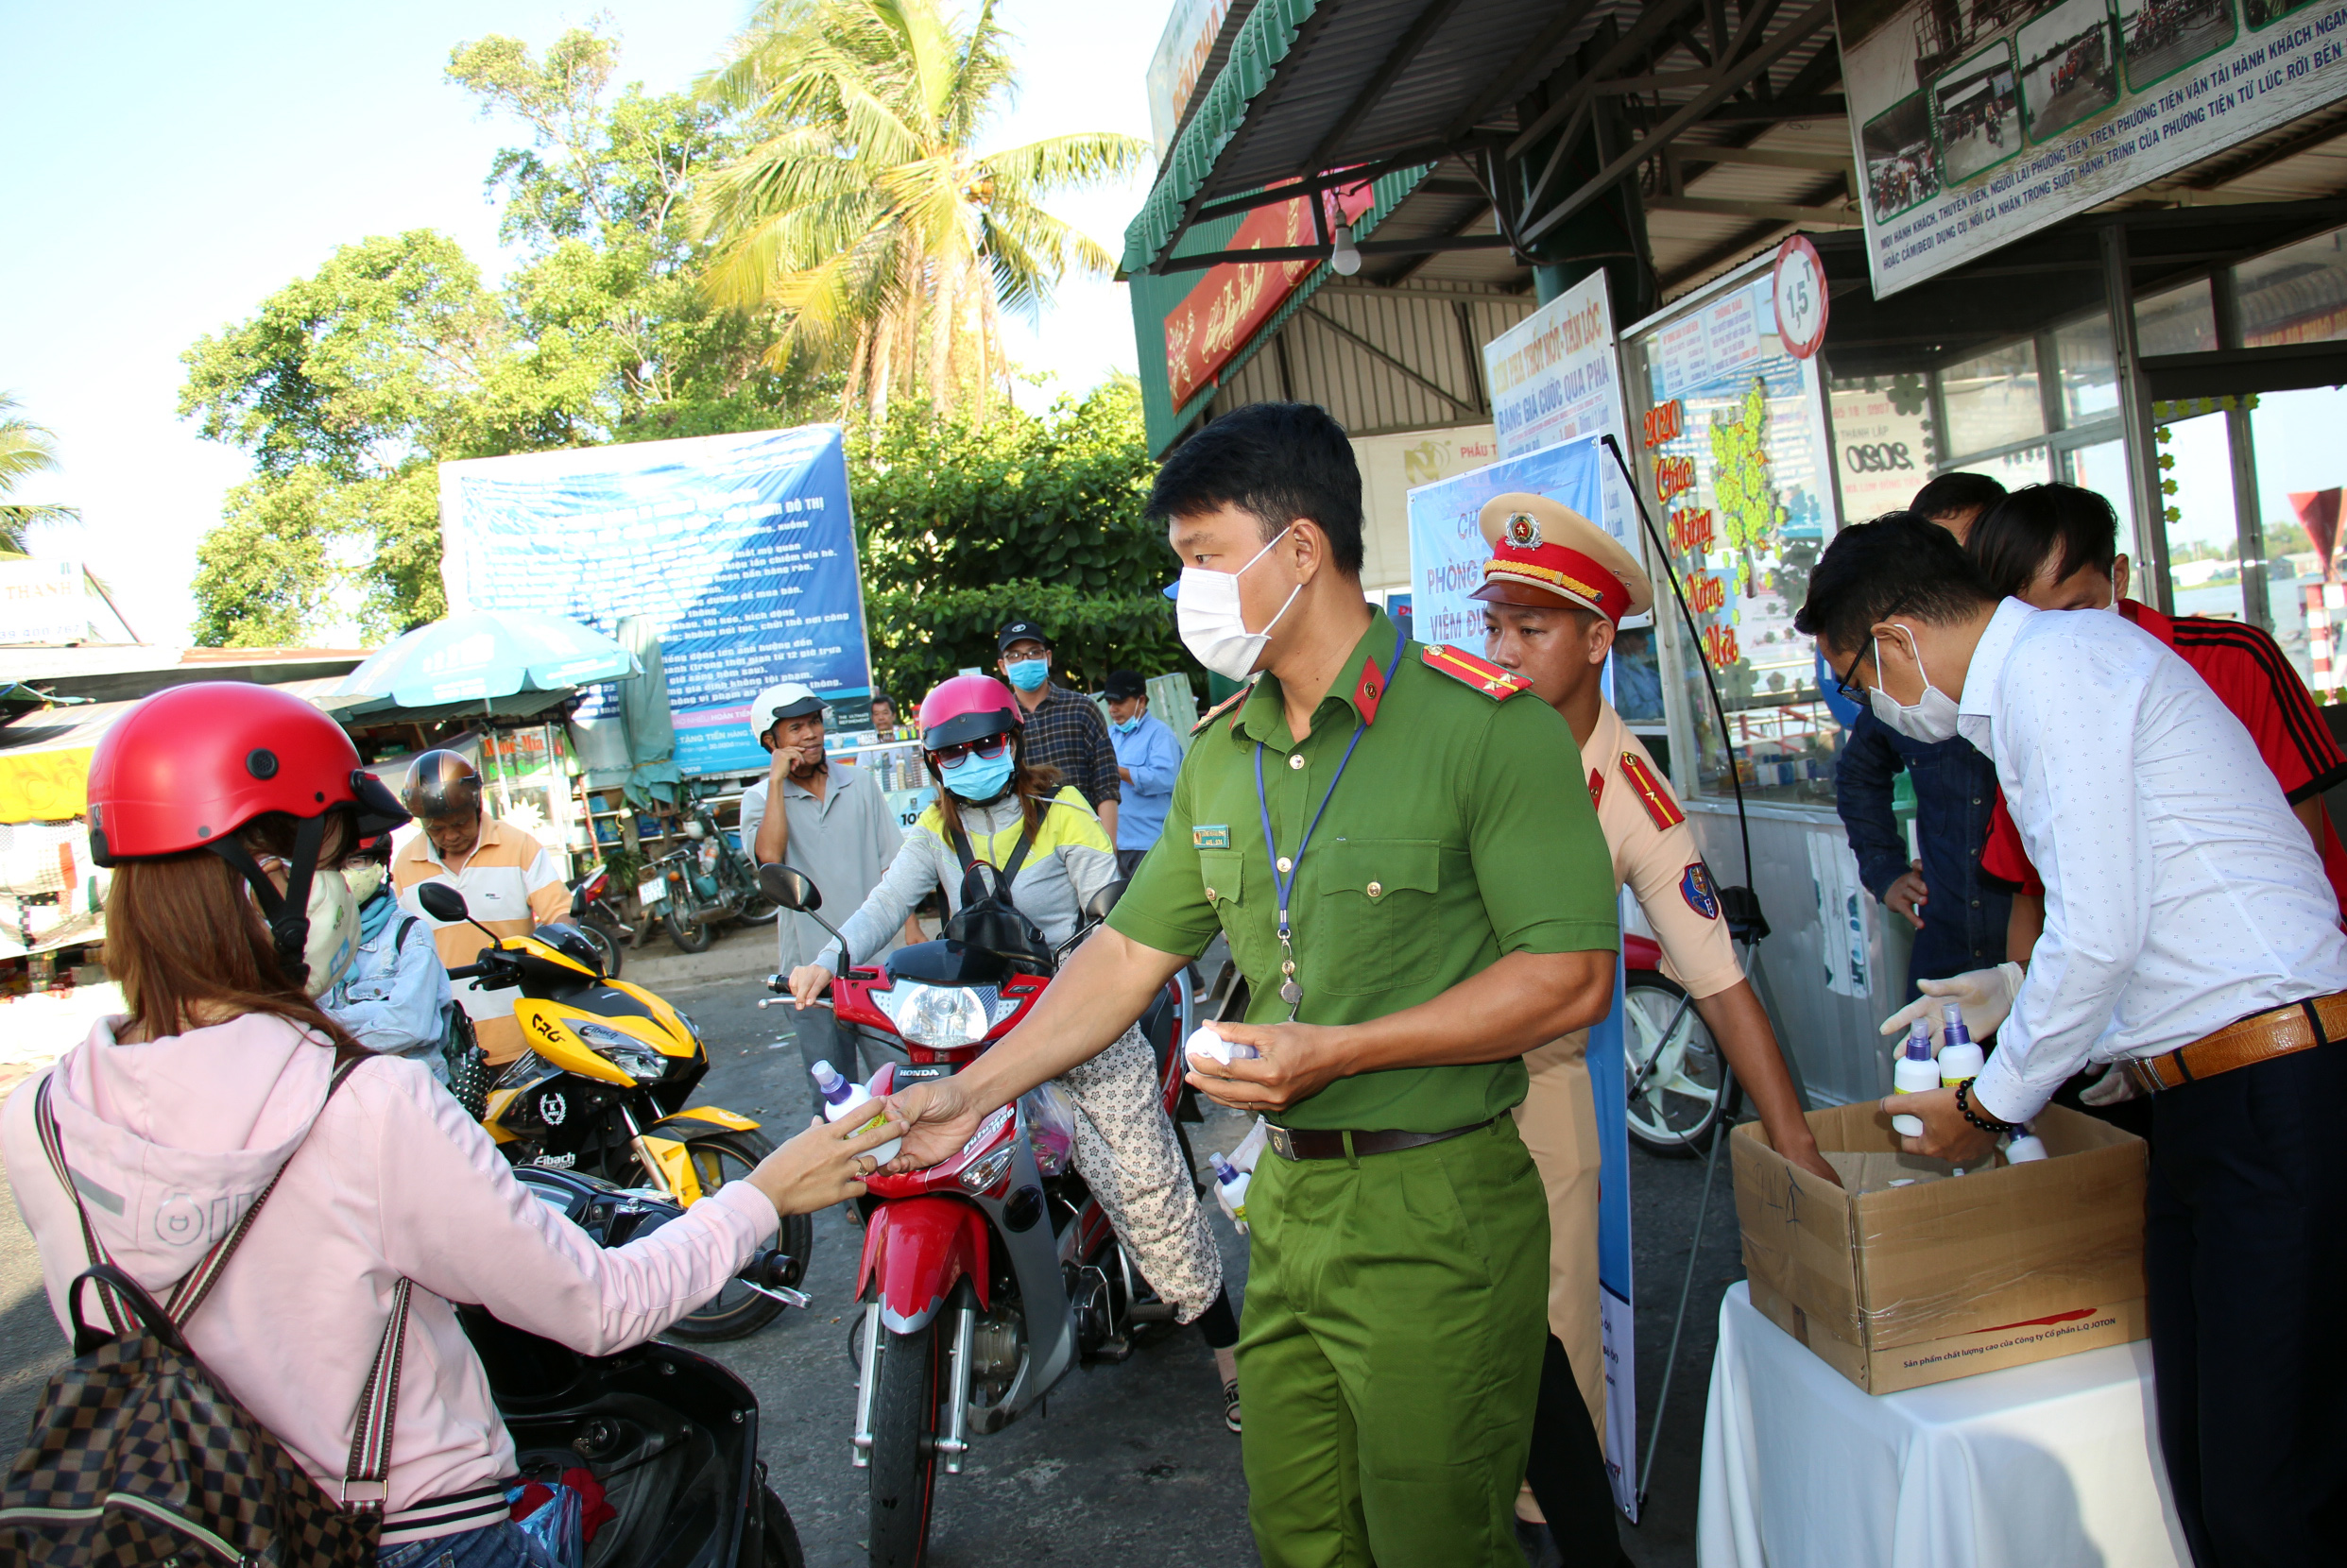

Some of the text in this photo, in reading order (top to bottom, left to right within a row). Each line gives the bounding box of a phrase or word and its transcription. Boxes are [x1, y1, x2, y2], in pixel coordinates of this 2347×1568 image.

[1893, 225, 1912, 244] HÀNH
[1913, 211, 1938, 233] KHÁCH,
[2031, 149, 2066, 176] PHƯƠNG
[2089, 121, 2116, 144] TRÊN
[2117, 102, 2157, 131] PHƯƠNG
[2158, 87, 2184, 112] TIỆN
[2184, 77, 2208, 102] VẬN
[2209, 62, 2230, 88] TẢI
[2233, 48, 2266, 77] HÀNH
[2269, 26, 2312, 60] KHÁCH
[1936, 226, 1956, 247] DỤNG
[1998, 195, 2022, 215] NHÂN
[2023, 183, 2051, 205] TRONG
[2052, 167, 2075, 191] SUỐT
[2106, 138, 2136, 165] TRÌNH
[2138, 127, 2160, 151] CỦA
[2163, 107, 2206, 141] PHƯƠNG
[2207, 93, 2236, 119] TIỆN
[2236, 80, 2254, 103] TỪ
[2258, 67, 2284, 94] LÚC
[2286, 54, 2310, 81] RỜI
[2313, 38, 2343, 68] BẾN
[1787, 261, 1811, 330] 1,5 T
[1498, 399, 1522, 435] BẢNG
[1523, 387, 1538, 423] GIÁ
[1538, 377, 1564, 416] CƯỚC
[1564, 367, 1585, 404] QUA
[1586, 349, 1610, 391] PHÀ
[1644, 400, 1680, 450] 2020
[785, 497, 825, 513] ĐÔ THỊ
[1458, 510, 1482, 540] CH
[769, 554, 800, 565] chiếm
[776, 543, 801, 554] quan
[764, 566, 789, 576] hàng
[791, 563, 814, 572] rào.
[1428, 557, 1478, 595] PHÒNG
[6, 582, 72, 600] THANH
[707, 594, 739, 605] đường
[756, 589, 778, 599] mua
[672, 620, 701, 630] nhau,
[745, 611, 767, 622] kích
[769, 608, 796, 620] động
[688, 607, 721, 618] thông.
[1430, 606, 1462, 641] VIÊM
[684, 628, 715, 639] không
[805, 614, 822, 624] nơi
[824, 611, 849, 623] công
[690, 649, 716, 660] động
[759, 640, 791, 653] hưởng
[793, 639, 813, 648] đến
[690, 660, 723, 672] (trong
[748, 654, 771, 665] gian
[799, 648, 817, 659] giờ
[819, 646, 842, 656] trưa
[669, 666, 768, 686] giờ sáng hôm sau).
[685, 671, 814, 694] gia đình không tội phạm.
[698, 678, 843, 705] vi phạm an thông.
[711, 710, 734, 721] HOÀN
[521, 733, 544, 753] Mía
[679, 732, 703, 743] TẶNG
[1904, 1318, 2116, 1369] Sản phẩm chất lượng cao của Công ty Cổ phần L.Q JOTON
